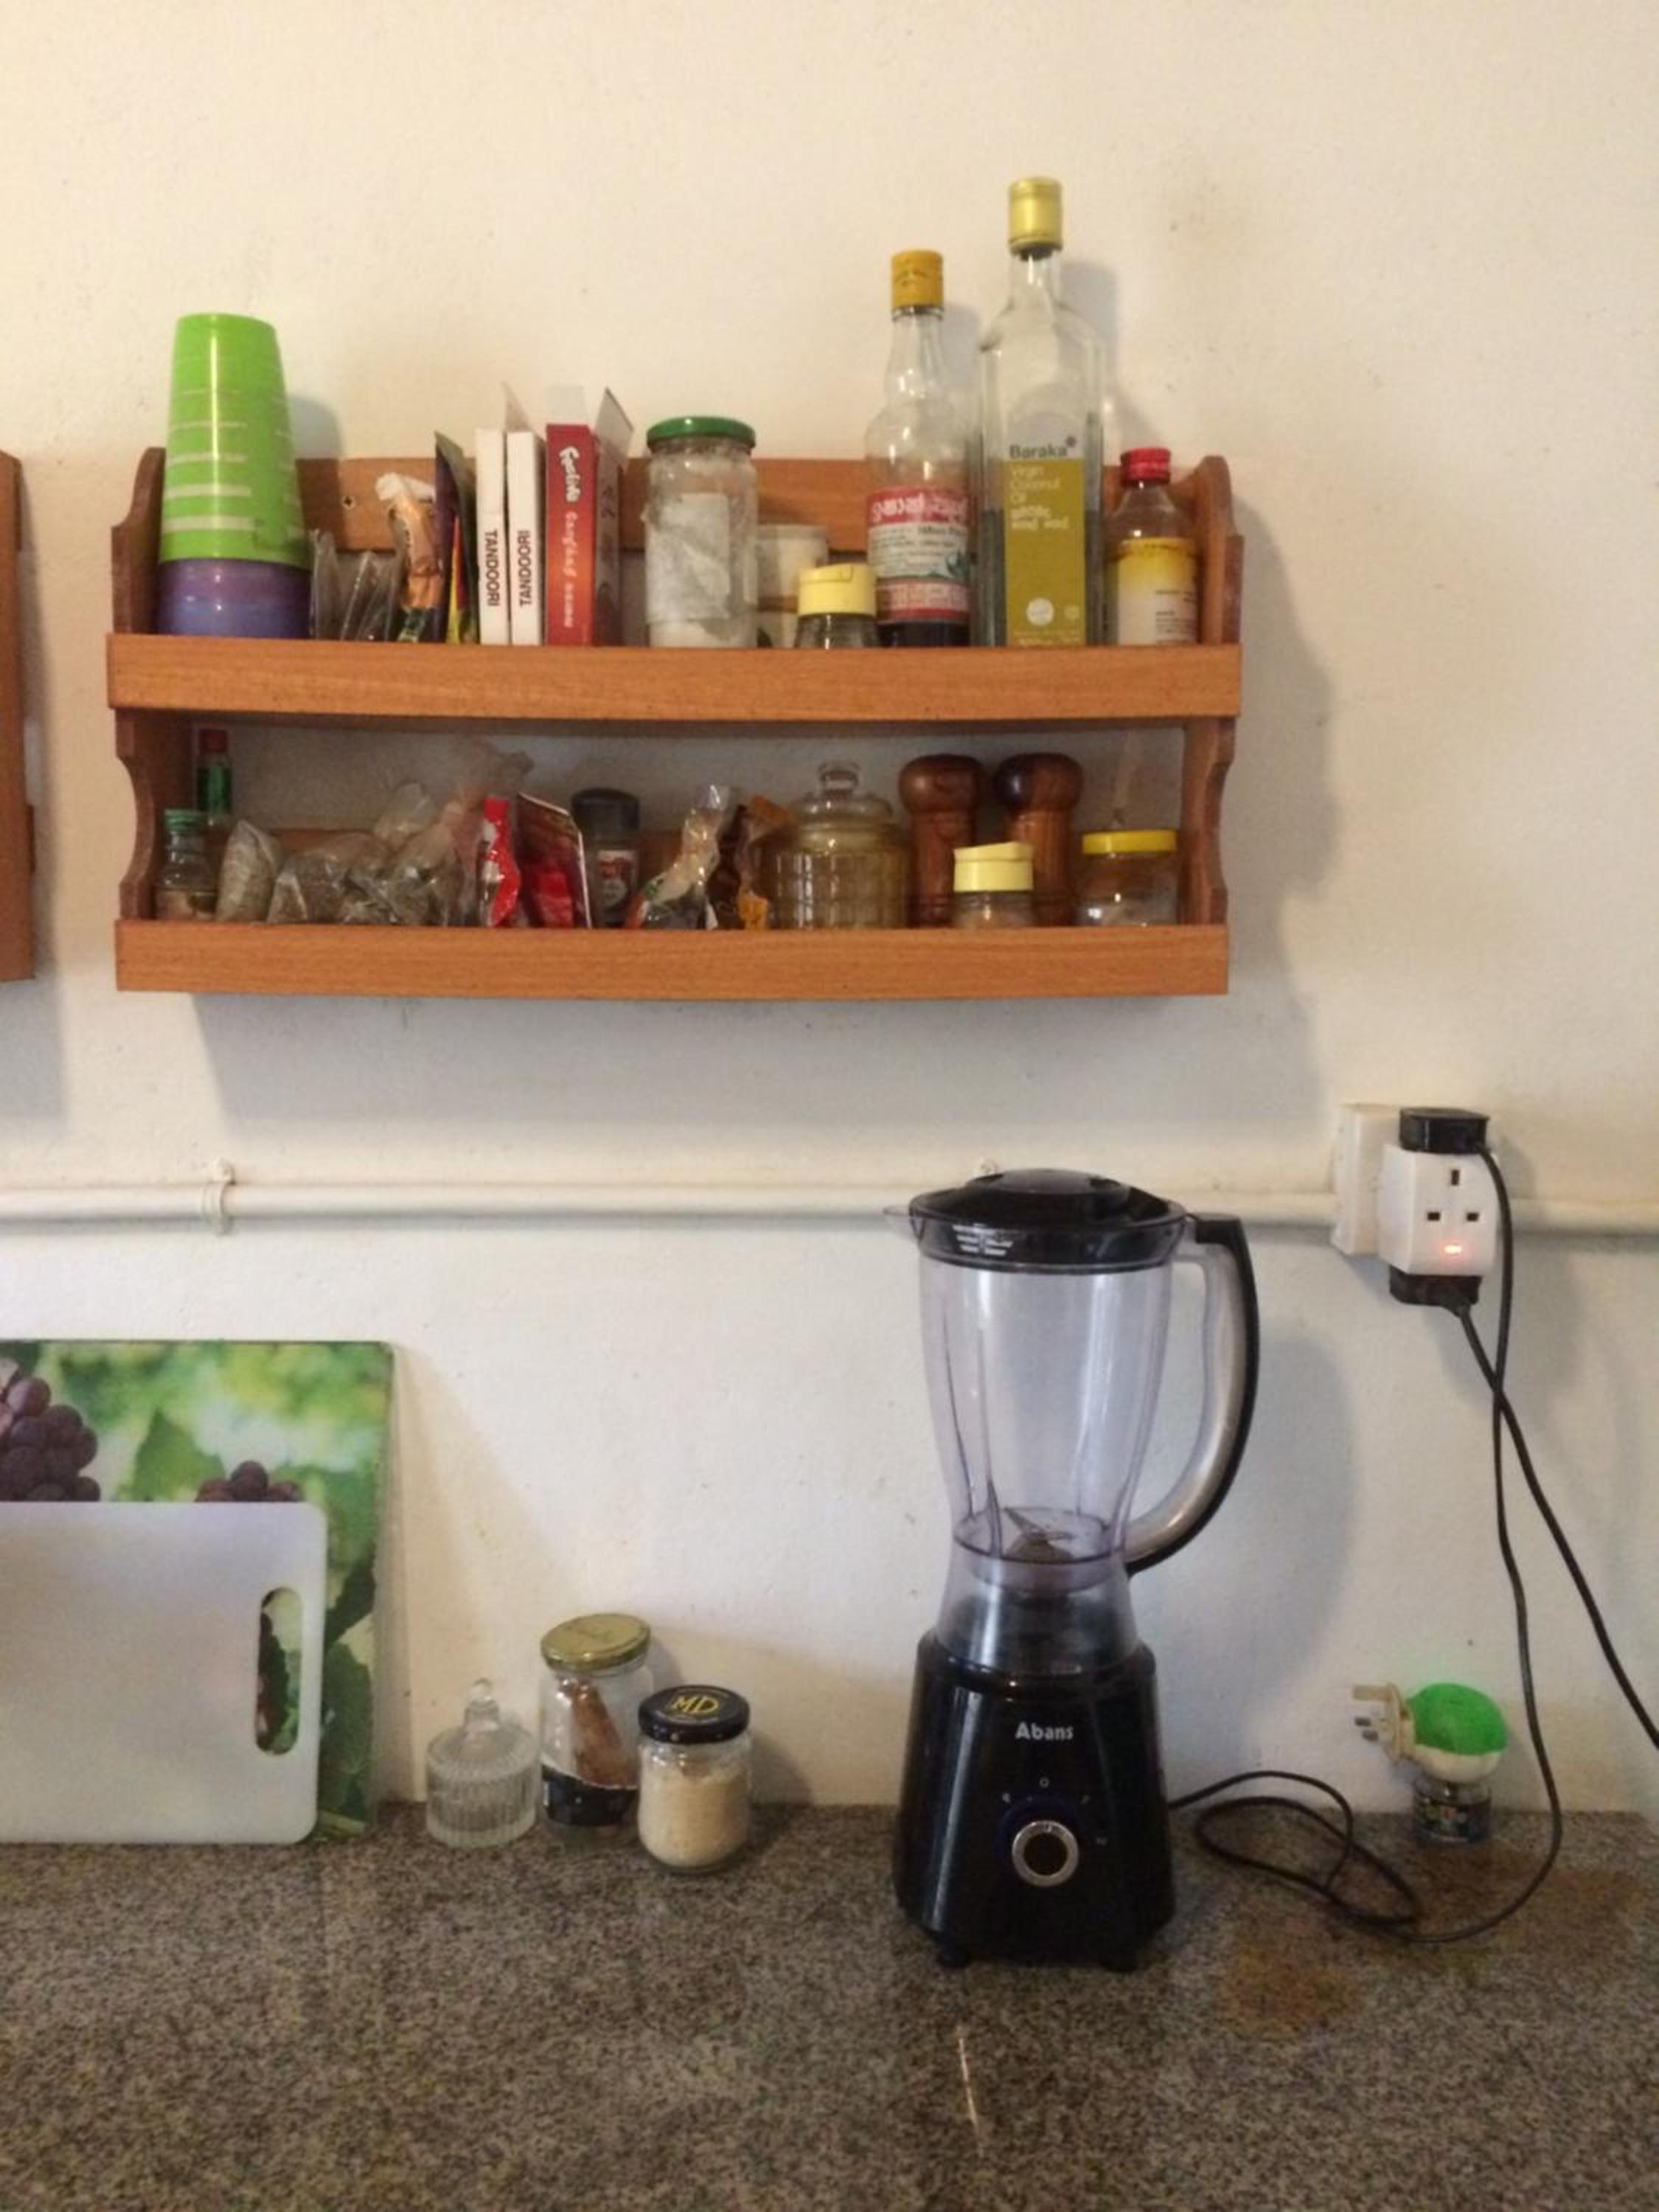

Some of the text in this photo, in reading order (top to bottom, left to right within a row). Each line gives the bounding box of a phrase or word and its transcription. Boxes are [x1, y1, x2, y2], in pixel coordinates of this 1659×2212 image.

[1009, 444, 1068, 458] Baraka
[485, 529, 500, 606] TANDOORI
[518, 530, 532, 607] TANDOORI
[672, 1696, 719, 1714] MD
[1015, 1722, 1074, 1741] Abans
